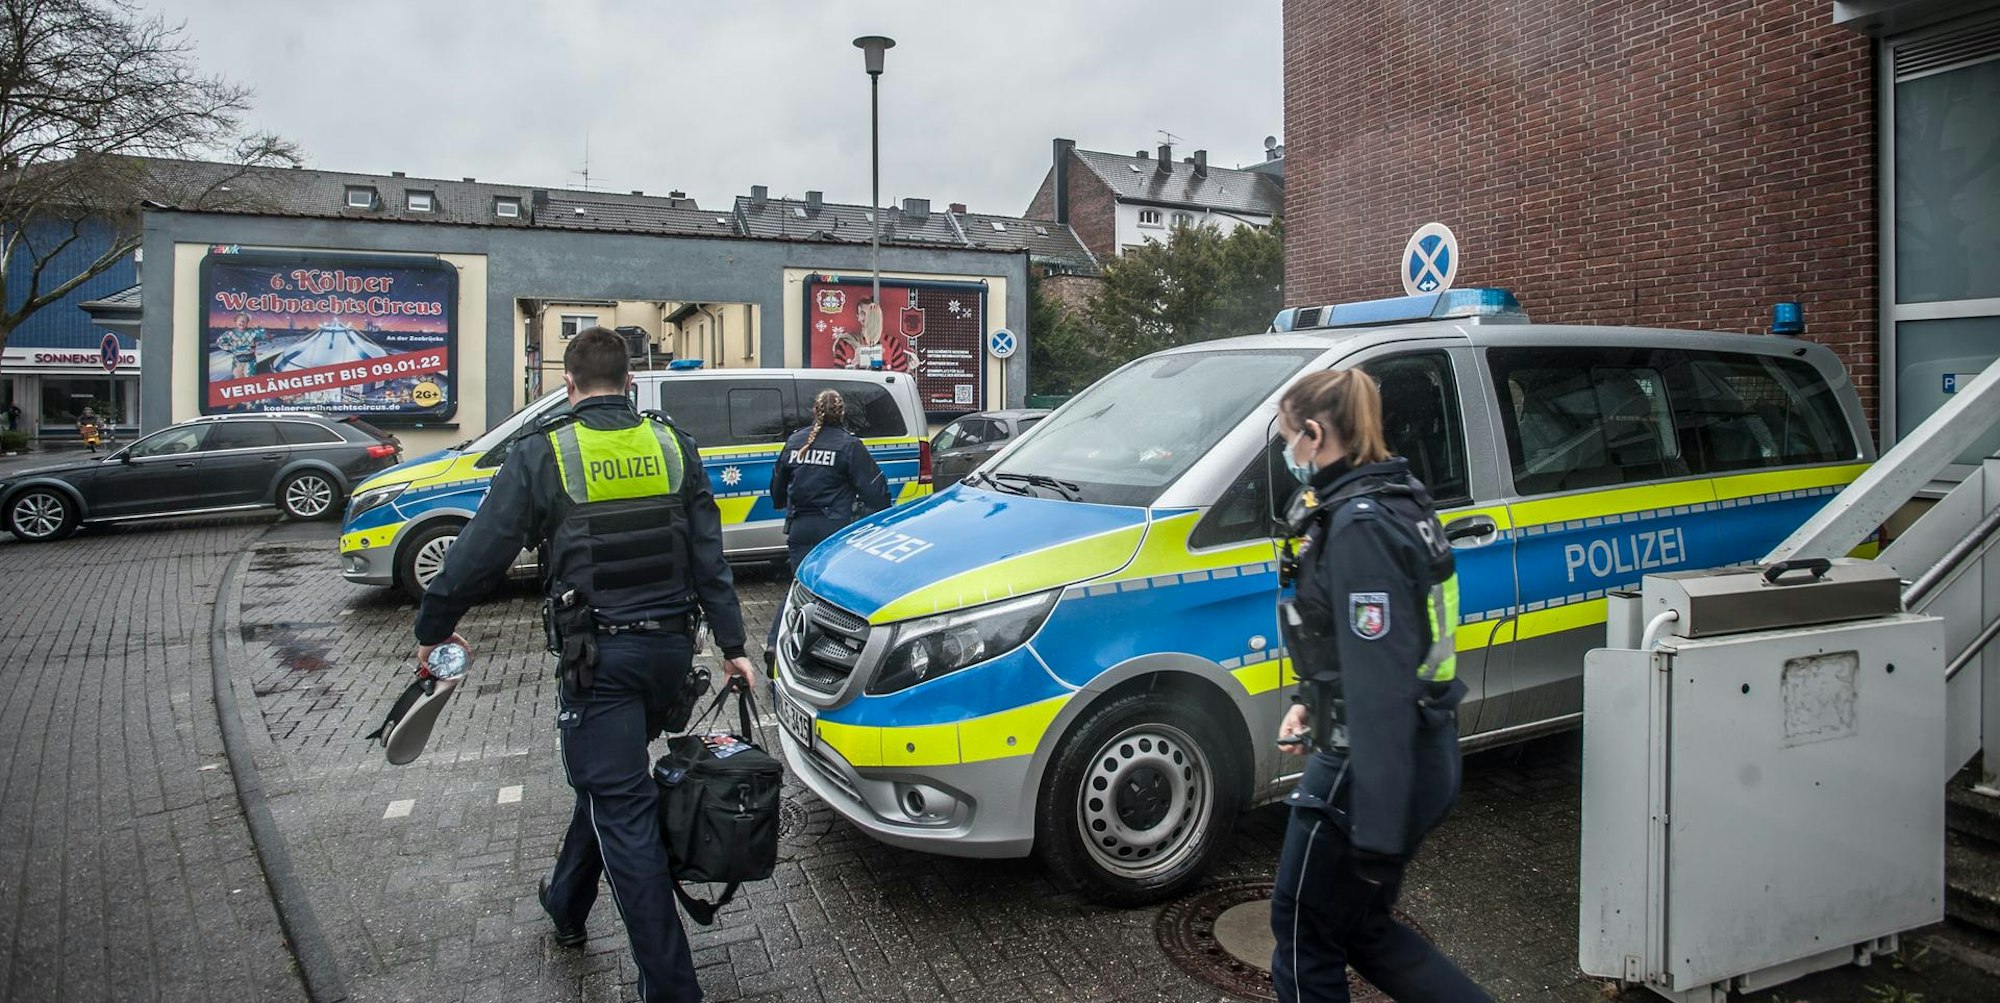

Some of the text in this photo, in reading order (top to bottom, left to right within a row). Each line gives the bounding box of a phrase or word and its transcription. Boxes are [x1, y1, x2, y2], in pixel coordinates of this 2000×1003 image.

[270, 269, 394, 294] 6. Kölner
[216, 291, 442, 316] WeihnachtsCircus
[35, 353, 135, 364] SONNENSTDIO
[220, 355, 441, 399] VERLÄNGERT BIS 09.01.22
[1944, 377, 1955, 389] P
[415, 390, 439, 399] 2G+
[590, 455, 662, 482] POLIZEI
[1564, 527, 1687, 583] POLIZEI
